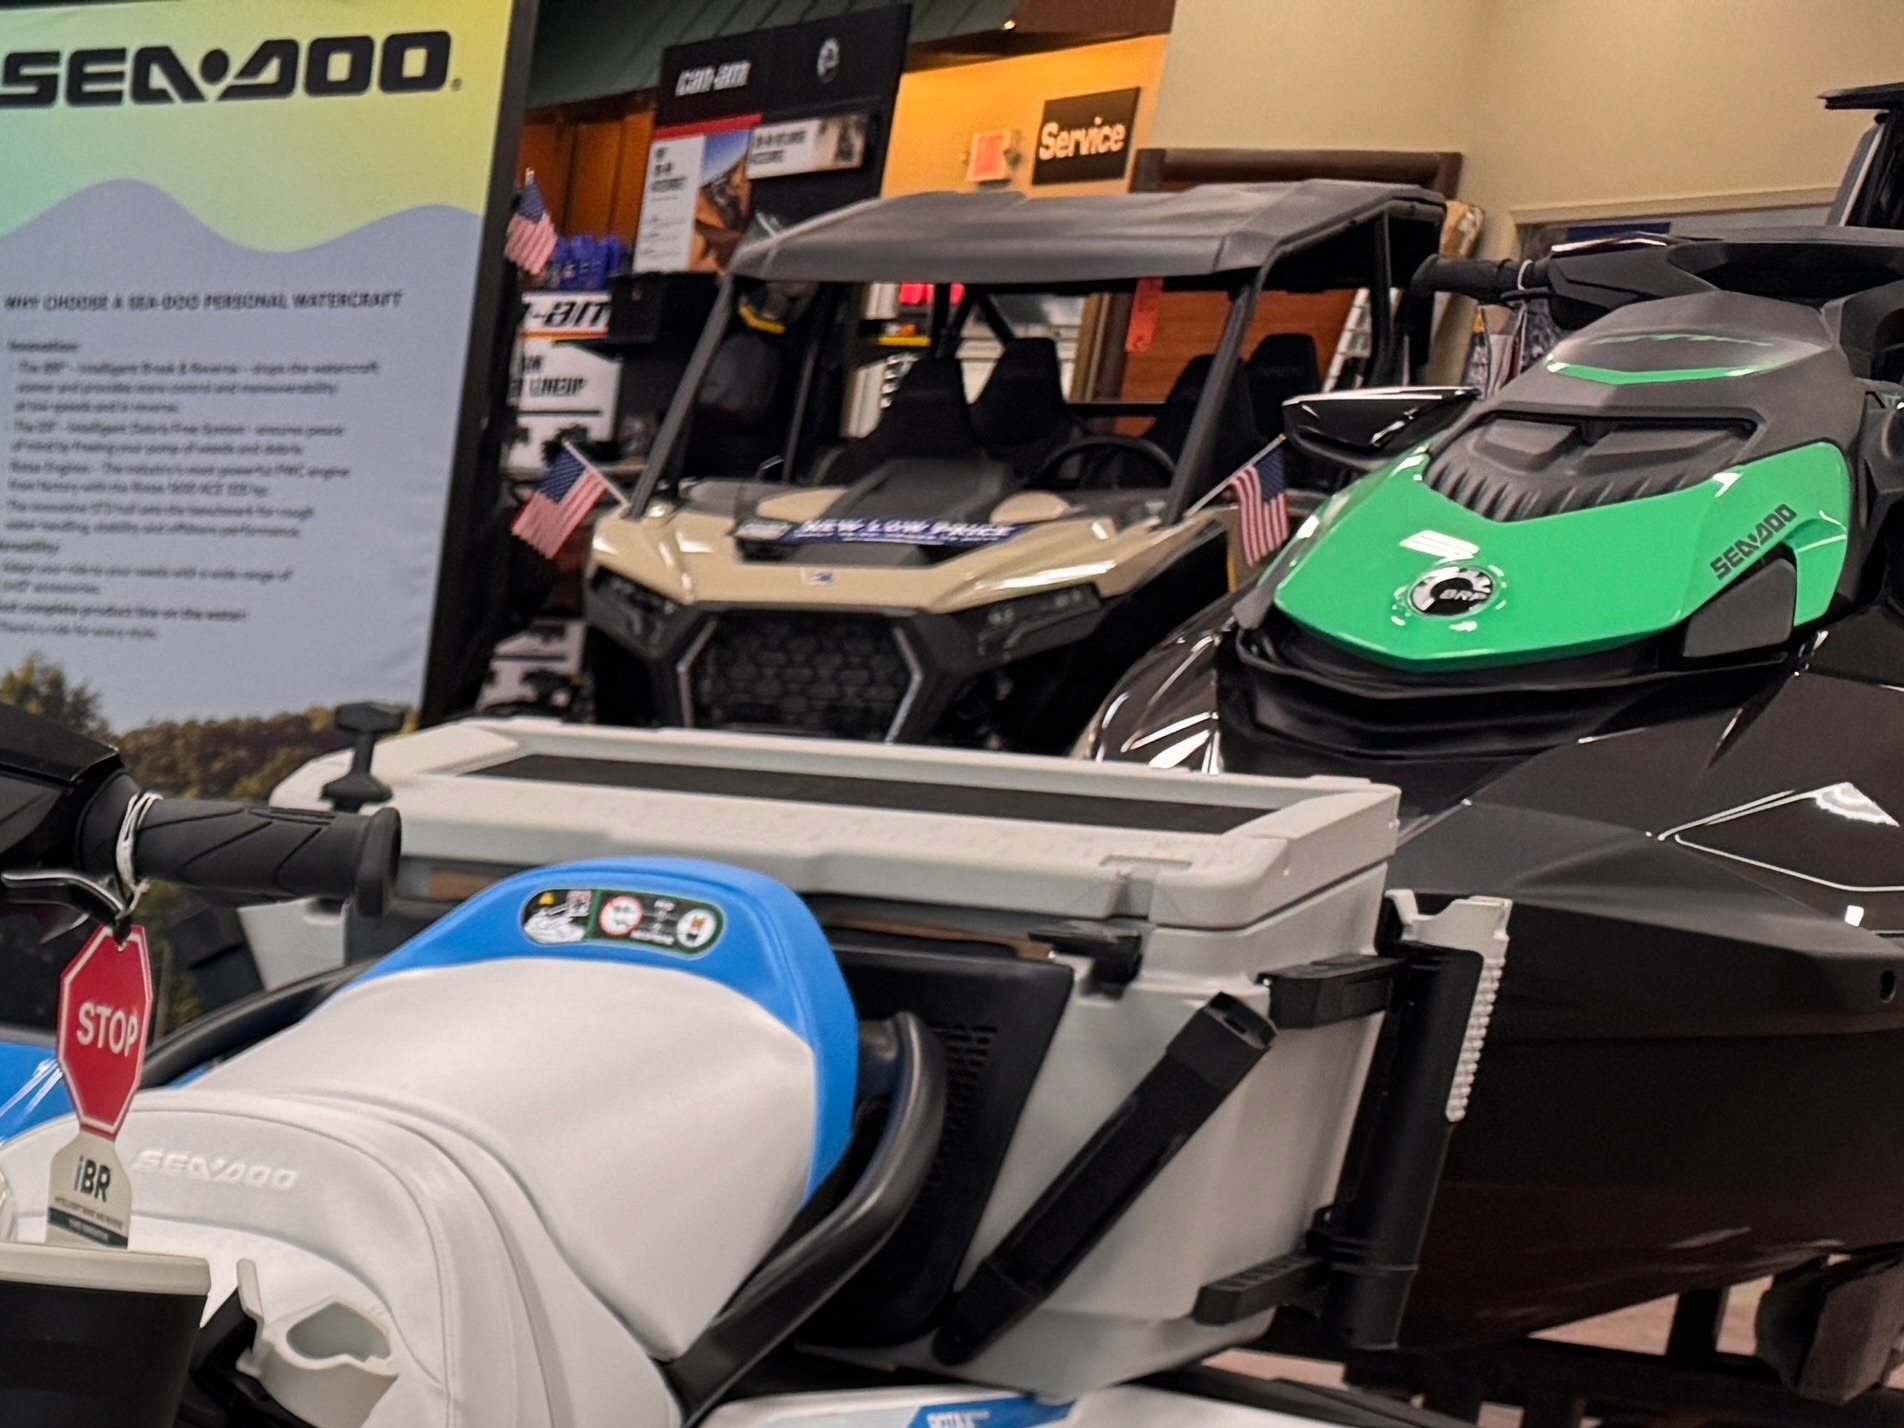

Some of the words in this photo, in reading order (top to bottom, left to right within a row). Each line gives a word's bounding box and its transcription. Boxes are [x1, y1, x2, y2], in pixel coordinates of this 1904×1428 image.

[1039, 116, 1126, 161] Service
[77, 1001, 138, 1057] STOP
[74, 1155, 112, 1202] iBR
